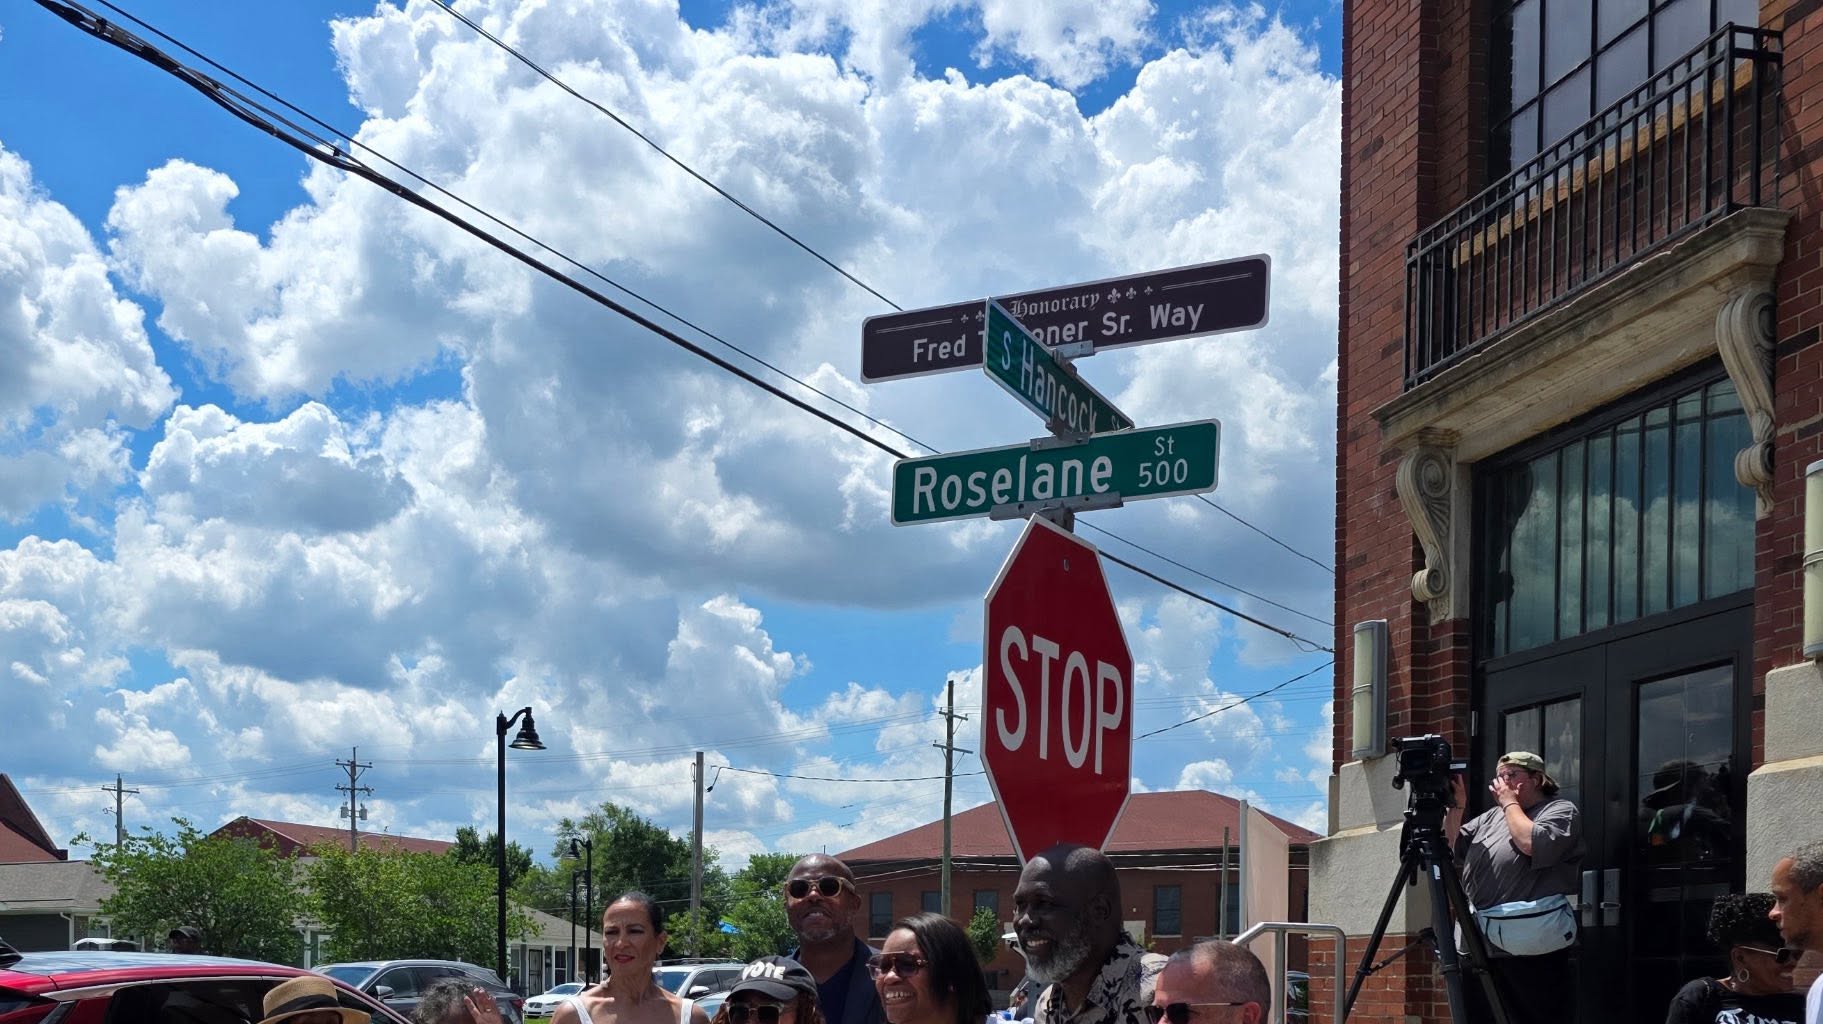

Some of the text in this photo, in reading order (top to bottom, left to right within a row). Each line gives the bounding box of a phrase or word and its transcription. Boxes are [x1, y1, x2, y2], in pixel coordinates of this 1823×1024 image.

[913, 333, 966, 363] Fred
[1101, 312, 1133, 336] Sr.
[1150, 303, 1204, 331] Way
[1010, 292, 1100, 318] Honorary
[1001, 331, 1012, 371] S
[1020, 339, 1098, 433] Hancock
[912, 435, 1174, 514] Roselane St
[1138, 458, 1188, 488] 500
[996, 625, 1124, 775] STOP
[742, 961, 786, 980] VOTE
